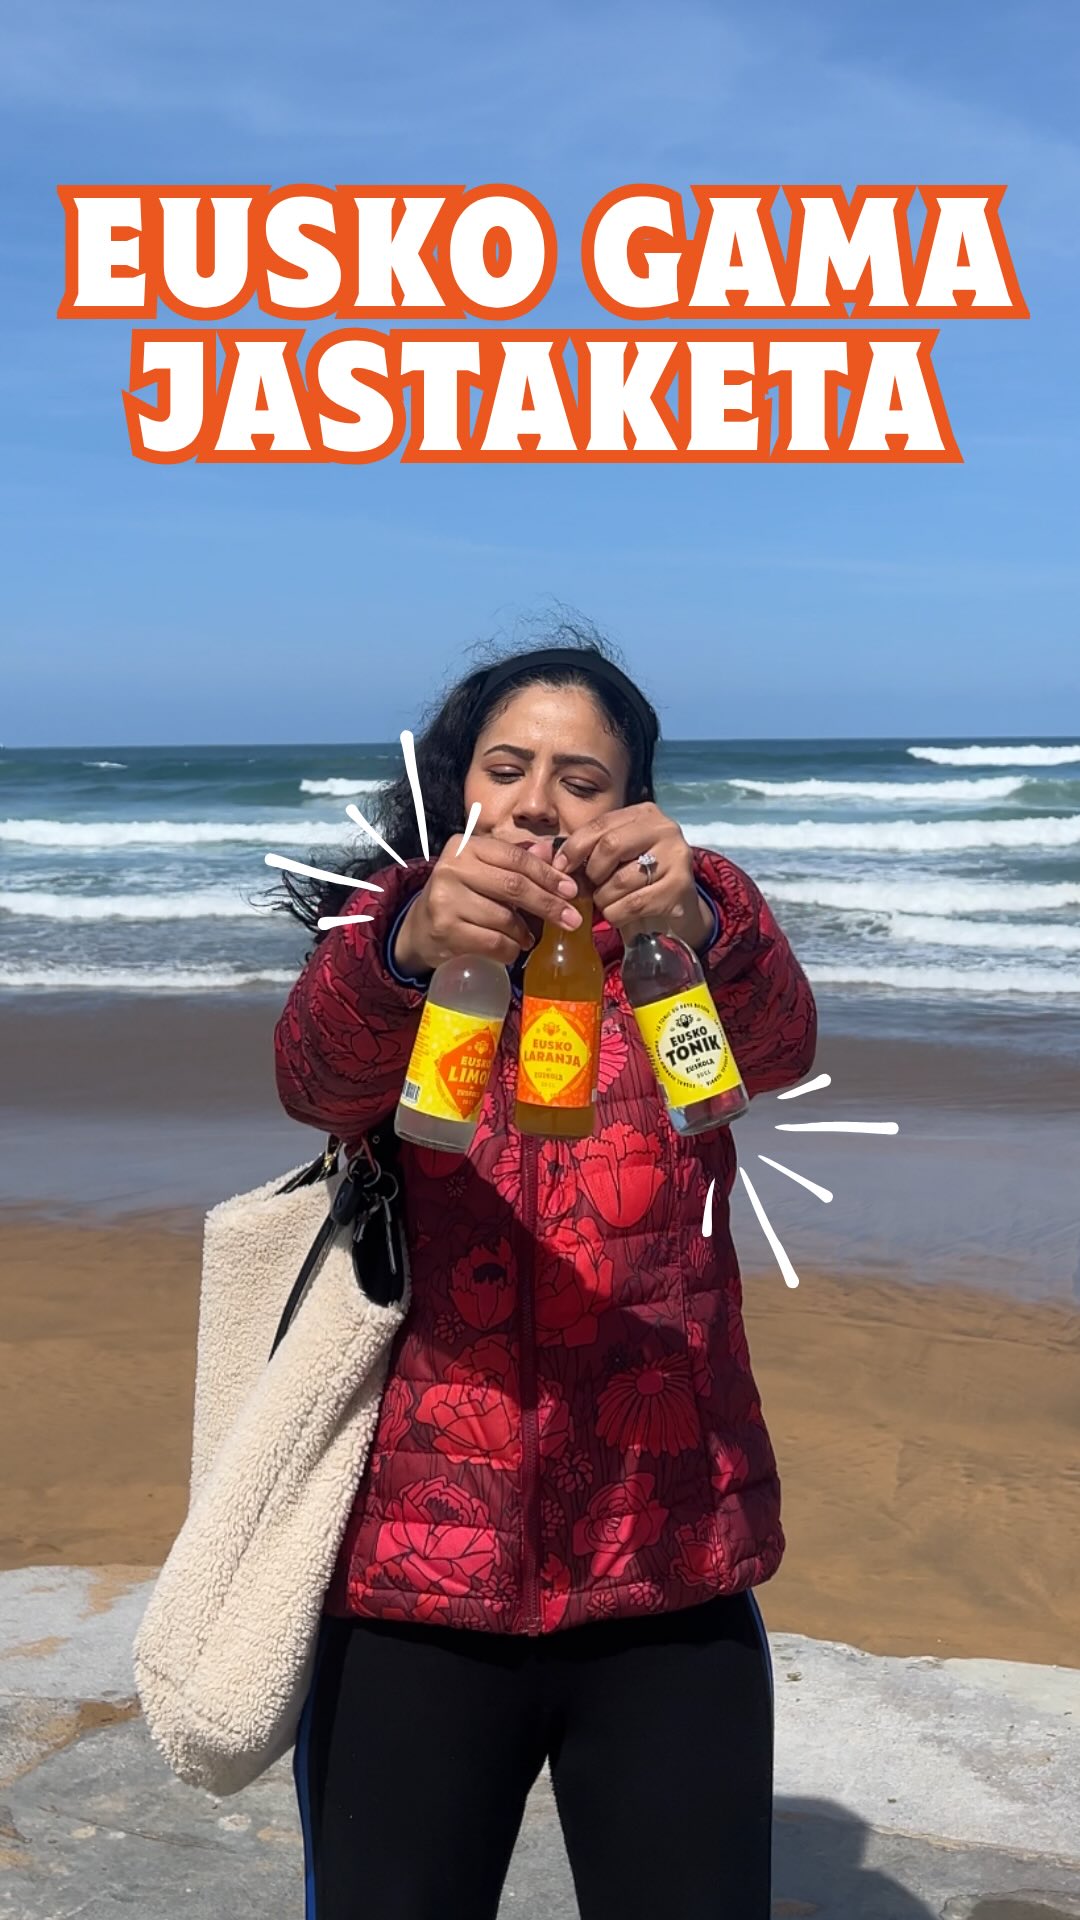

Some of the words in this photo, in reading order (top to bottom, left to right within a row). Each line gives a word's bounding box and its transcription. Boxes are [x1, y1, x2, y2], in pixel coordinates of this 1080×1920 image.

[670, 1026, 707, 1047] EUSKO
[532, 1039, 572, 1051] EUSKO
[665, 1035, 721, 1067] TONIK
[461, 1056, 490, 1067] EUSKO
[524, 1050, 581, 1067] LARANJA
[685, 1059, 715, 1074] EUSKOLA
